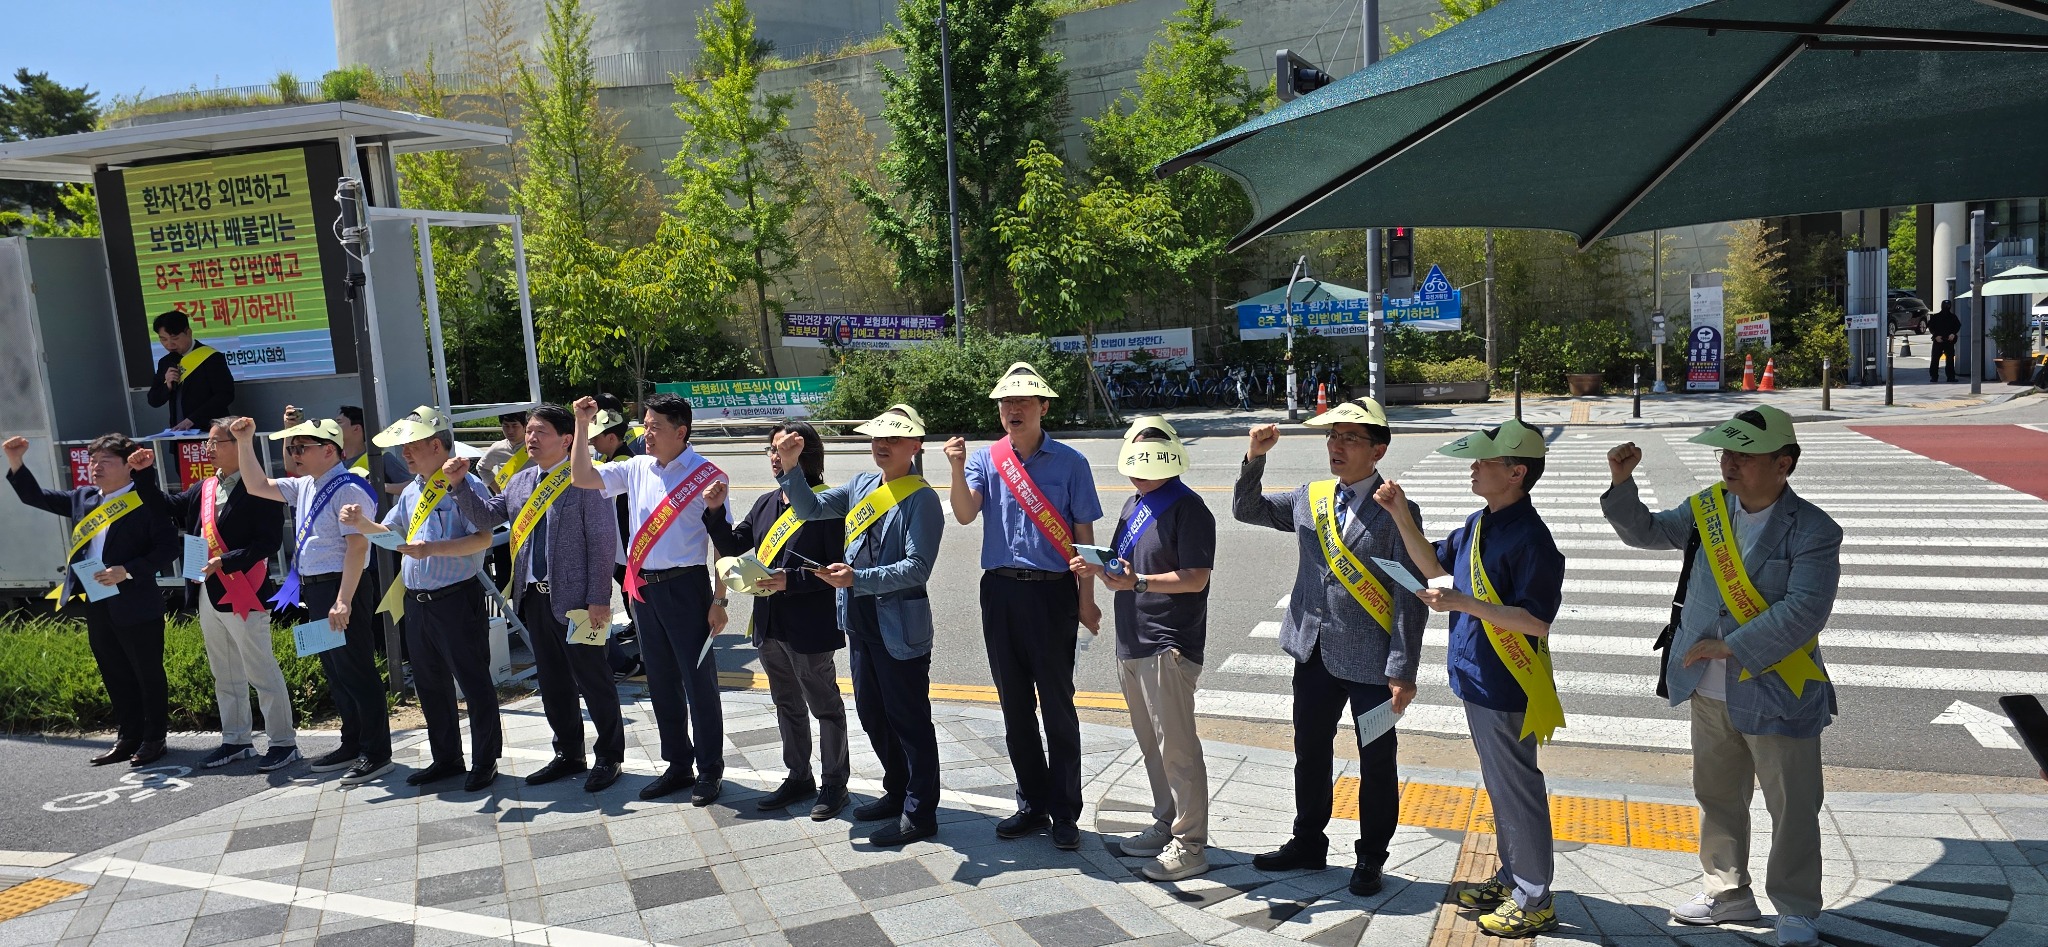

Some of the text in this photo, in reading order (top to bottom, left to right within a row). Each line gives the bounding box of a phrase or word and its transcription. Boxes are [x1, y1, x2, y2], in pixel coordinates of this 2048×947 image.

[142, 173, 290, 215] 환자건강 외면하고
[150, 213, 296, 253] 보험회사 배불리는
[155, 252, 302, 291] 8주 제한 입법예고
[211, 292, 297, 326] 폐기하라!!
[1257, 315, 1277, 327] 8주
[1308, 311, 1355, 325] 입법예고
[1386, 306, 1440, 320] 폐기하라!
[1308, 299, 1332, 312] 환자
[787, 325, 820, 338] 국토부의
[788, 314, 822, 326] 국민건강
[864, 316, 899, 329] 보험회사
[901, 317, 937, 329] 배불리는
[1128, 335, 1166, 346] 보장한다.
[690, 379, 801, 396] 보험회사 셀프심사 OUT!
[707, 394, 746, 408] 포기하는
[748, 391, 787, 405] 졸속입법
[1722, 426, 1755, 447] 폐기
[1125, 451, 1182, 466] 즉각 폐기
[532, 485, 556, 512] 피해자의
[668, 480, 699, 509] 제한하는
[1001, 456, 1023, 485] 치료권
[1015, 478, 1044, 518] 제한하는
[1704, 513, 1726, 548] 피해자의
[1713, 543, 1739, 583] 진료권을
[1356, 578, 1393, 619] 보장하라!
[1499, 632, 1534, 677] 보장하라!
